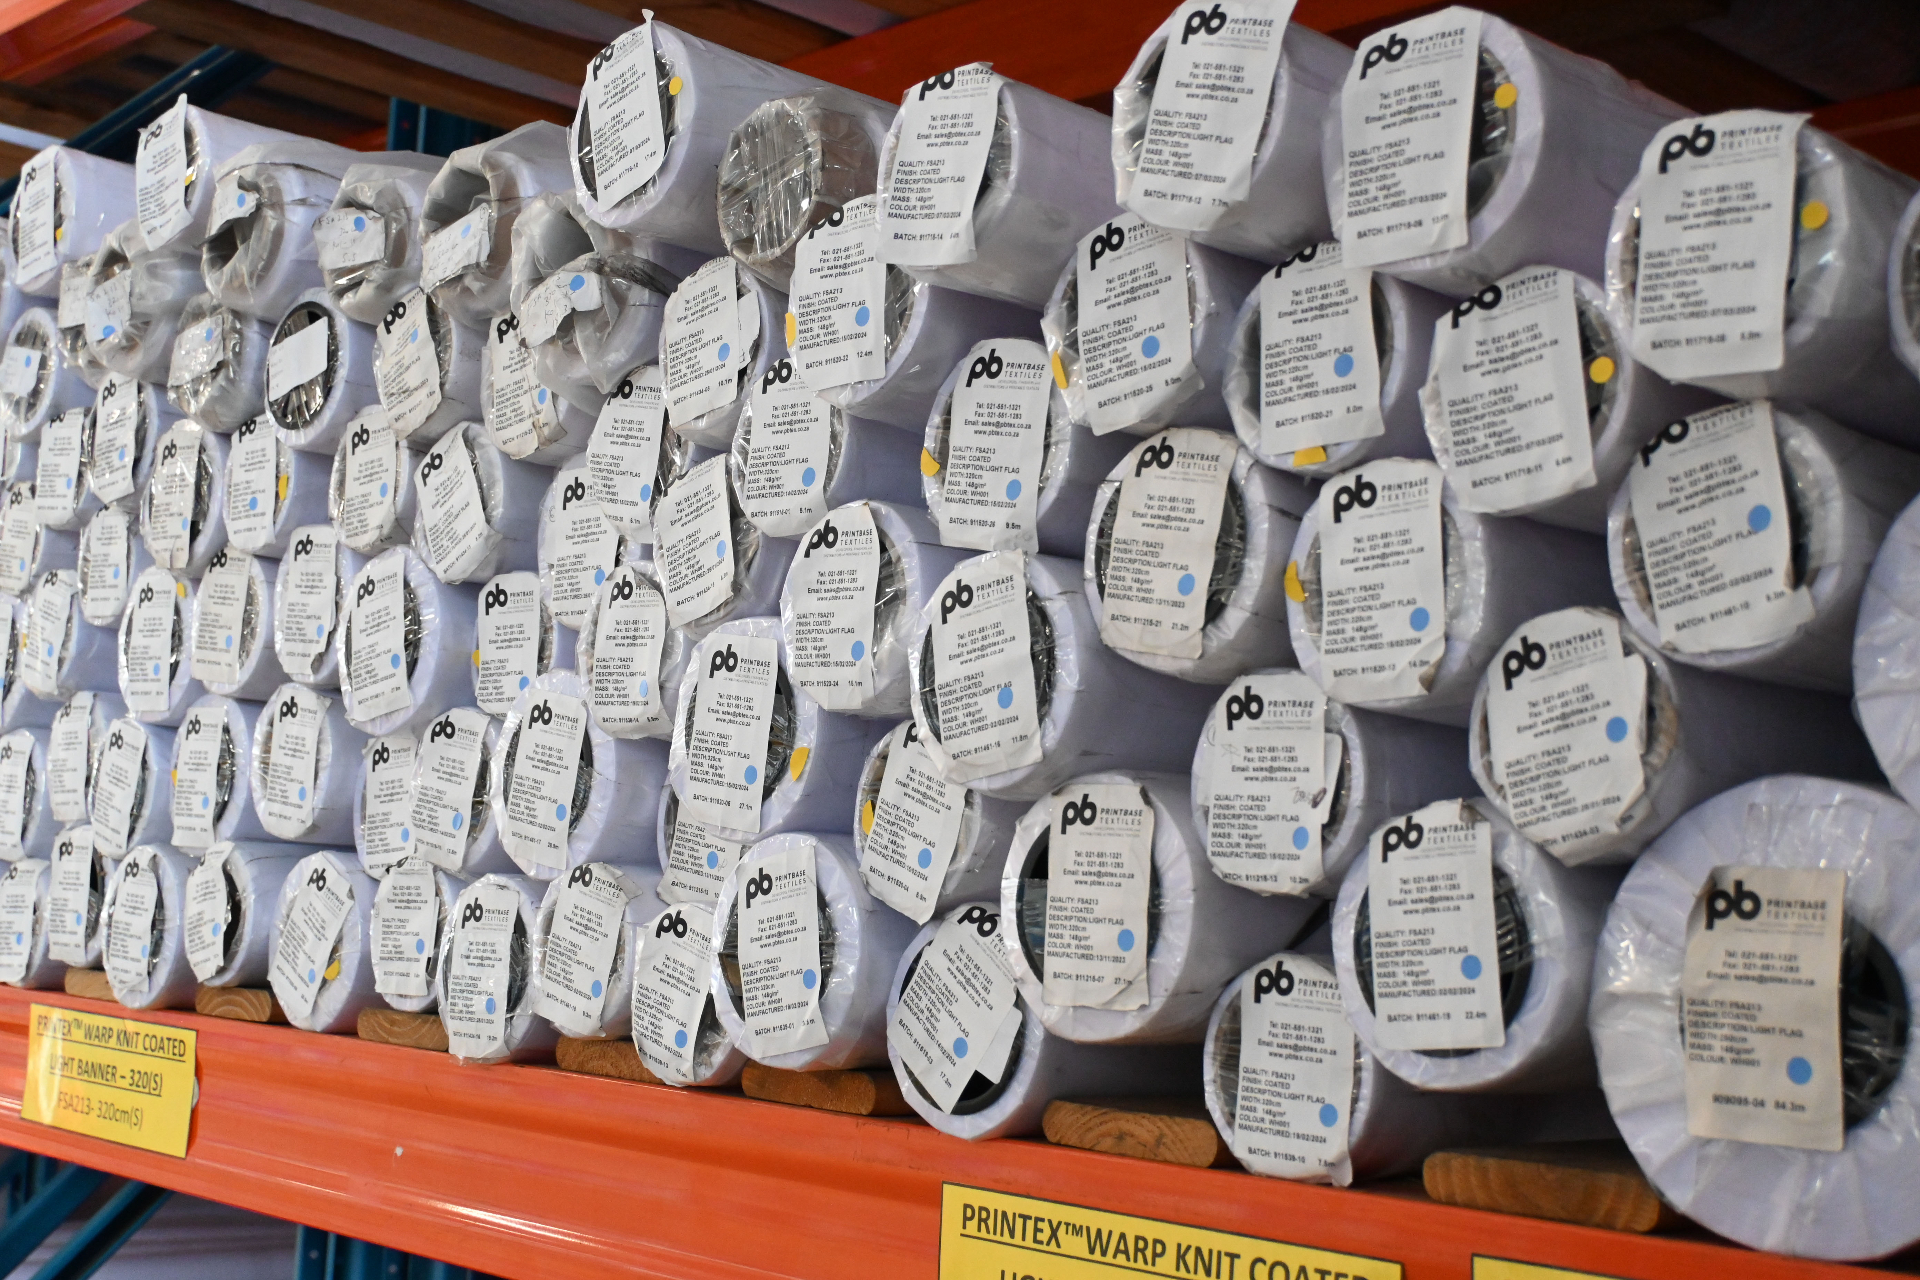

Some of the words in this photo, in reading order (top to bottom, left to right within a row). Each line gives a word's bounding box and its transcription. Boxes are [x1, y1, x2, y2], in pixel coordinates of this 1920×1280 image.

[1181, 4, 1227, 45] pb
[1229, 18, 1274, 28] PRINTBASE
[1225, 27, 1271, 37] TEXTILES
[1413, 28, 1466, 47] PRINTBASE
[1411, 37, 1464, 54] TEXTILES
[1360, 33, 1408, 80] pb
[957, 77, 991, 87] TEXTILES
[1659, 124, 1715, 174] pb
[1090, 222, 1124, 271] pb
[1506, 270, 1558, 291] PRINTBASE
[1095, 296, 1111, 306] Email:
[1114, 276, 1172, 299] sales@pbtex.co.za
[1506, 279, 1558, 302] TEXTILES
[1107, 289, 1160, 310] www.pbtex.co.za
[1082, 324, 1111, 337] QUALITY:
[1149, 323, 1165, 333] FLAG
[1082, 335, 1106, 346] FINISH:
[1107, 325, 1134, 338] COATED
[966, 349, 1003, 387] pb
[1006, 362, 1045, 371] PRINTBASE
[1085, 362, 1104, 373] MASS:
[1004, 371, 1043, 379] TEXTILES
[1087, 369, 1114, 381] COLOUR:
[1098, 396, 1122, 408] BATCH:
[981, 420, 1031, 430] sales@pbtex.co.za
[974, 429, 1019, 437] www.pbtex.co.za
[1135, 437, 1175, 478] pb
[1178, 453, 1221, 463] PRINTBASE
[1176, 461, 1219, 472] TEXTILES
[1381, 477, 1429, 492] PRINTBASE
[1333, 474, 1376, 523] pb
[1381, 488, 1429, 501] TEXTILES
[949, 517, 968, 525] BATCH:
[804, 519, 838, 558] pb
[841, 529, 873, 537] PRINTBASE
[840, 537, 873, 545] TEXTILES
[1114, 538, 1141, 548] QUALITY:
[1114, 547, 1134, 556] FINISH:
[1135, 550, 1160, 559] COATED
[1172, 563, 1189, 571] FLAG
[376, 572, 397, 584] PRINTBASE
[976, 575, 1014, 593] PRINTBASE
[357, 575, 375, 607] pb
[509, 590, 534, 599] PRINTBASE
[977, 584, 1015, 601] TEXTILES
[1108, 583, 1134, 593] COLOUR:
[485, 583, 508, 615] pb
[509, 596, 534, 605] TEXTILES
[941, 579, 973, 625] pb
[1110, 613, 1132, 624] BATCH:
[1549, 628, 1604, 651] PRINTBASE
[1550, 639, 1606, 661] TEXTILES
[709, 644, 739, 678] pb
[740, 658, 771, 668] PRINTBASE
[1502, 635, 1546, 691] pb
[739, 666, 770, 675] TEXTILES
[1226, 686, 1264, 730] pb
[1268, 700, 1314, 709] PRINTBASE
[528, 699, 552, 729] pb
[554, 713, 578, 724] PRINTBASE
[1268, 709, 1312, 718] TEXTILES
[553, 720, 578, 731] TEXTILES
[1061, 794, 1097, 835] pb
[1100, 808, 1143, 817] PRINTBASE
[1100, 817, 1141, 825] TEXTILES
[1382, 816, 1424, 863] pb
[1427, 833, 1477, 845] TEXTILES
[775, 870, 806, 883] PRINTBASE
[1082, 871, 1135, 879] sales@pbtex.co.za
[746, 868, 773, 909] pb
[775, 878, 807, 890] TEXTILES
[1705, 880, 1761, 930] pb
[462, 898, 483, 930] pb
[1254, 961, 1295, 1003] pb
[37, 1014, 83, 1037] PRNTEX™
[84, 1023, 113, 1044] WARP
[116, 1028, 141, 1049] KNIT
[143, 1034, 186, 1057] COATED
[77, 1058, 117, 1083] BANNER
[129, 1069, 163, 1097] 320(S)
[96, 1100, 143, 1131] 320cm(S)
[1175, 1242, 1241, 1280] KNIT
[1250, 1255, 1369, 1280] COA
